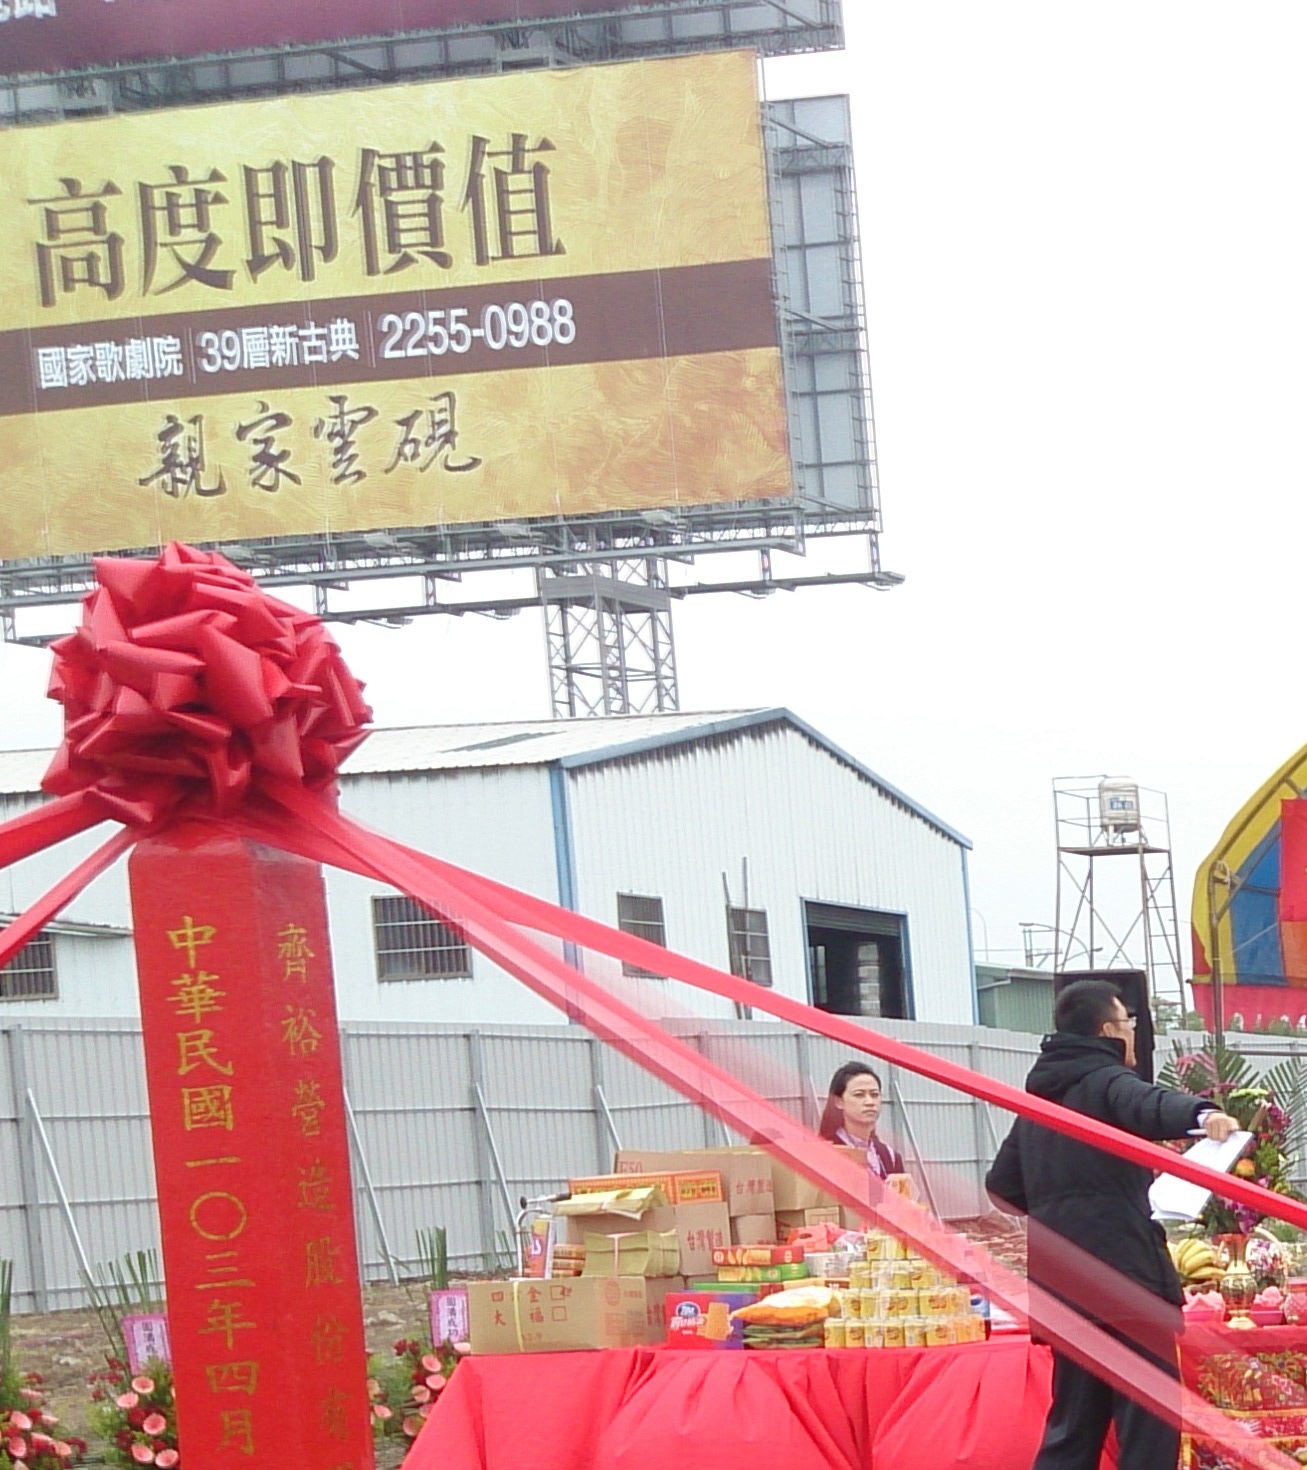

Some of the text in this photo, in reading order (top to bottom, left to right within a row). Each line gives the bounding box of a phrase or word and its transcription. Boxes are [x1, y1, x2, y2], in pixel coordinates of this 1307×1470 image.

[27, 133, 567, 308] 高度即價值
[37, 299, 577, 390] 國家歌劇院 39層新古典 2255-0988
